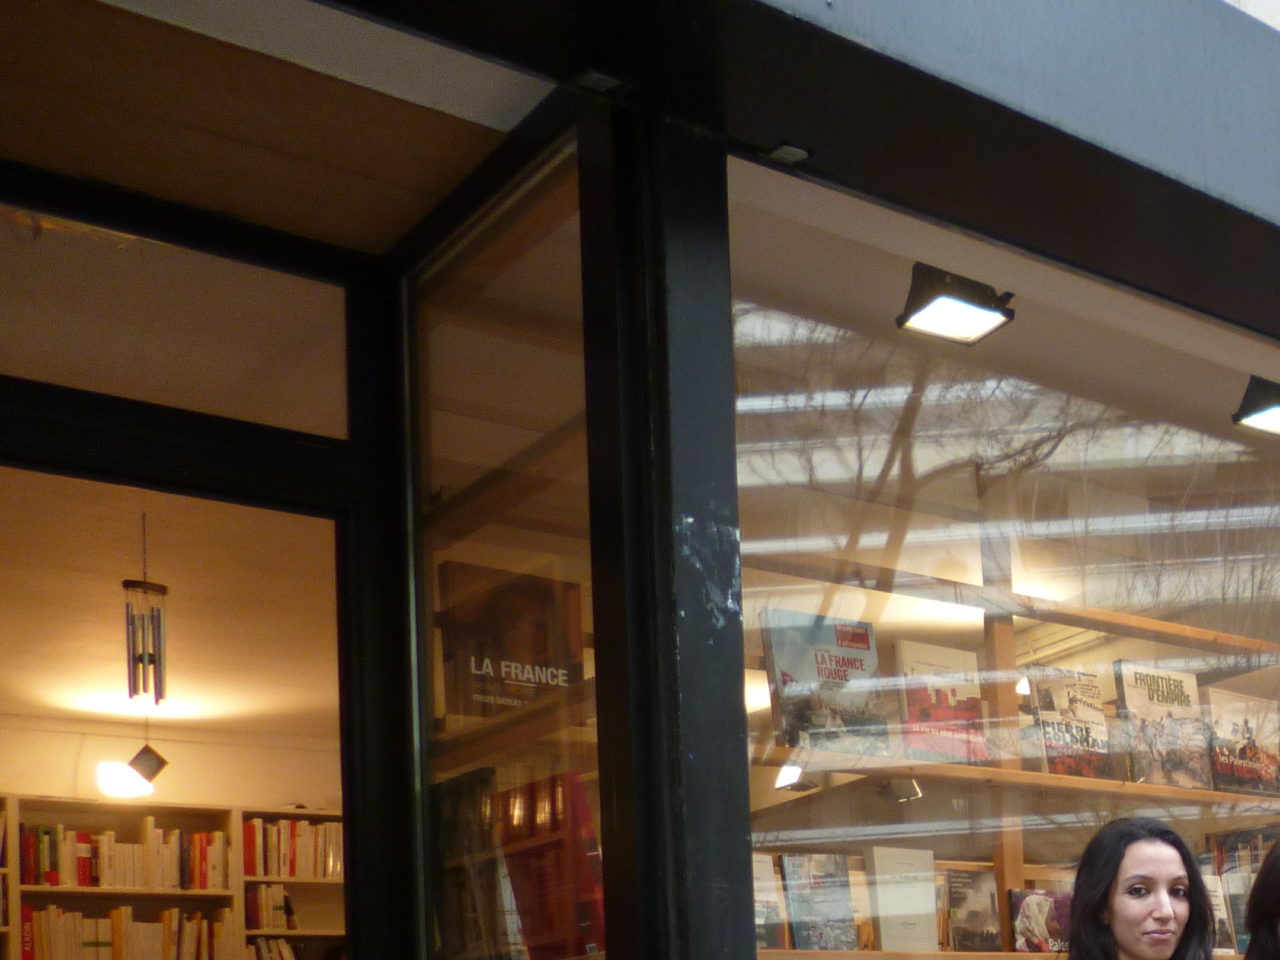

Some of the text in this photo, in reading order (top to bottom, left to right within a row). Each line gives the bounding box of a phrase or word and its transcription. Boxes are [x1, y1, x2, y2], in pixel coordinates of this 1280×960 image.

[470, 656, 569, 688] LA FRANCE
[829, 655, 866, 672] FRANCE
[816, 666, 850, 682] ROUGE
